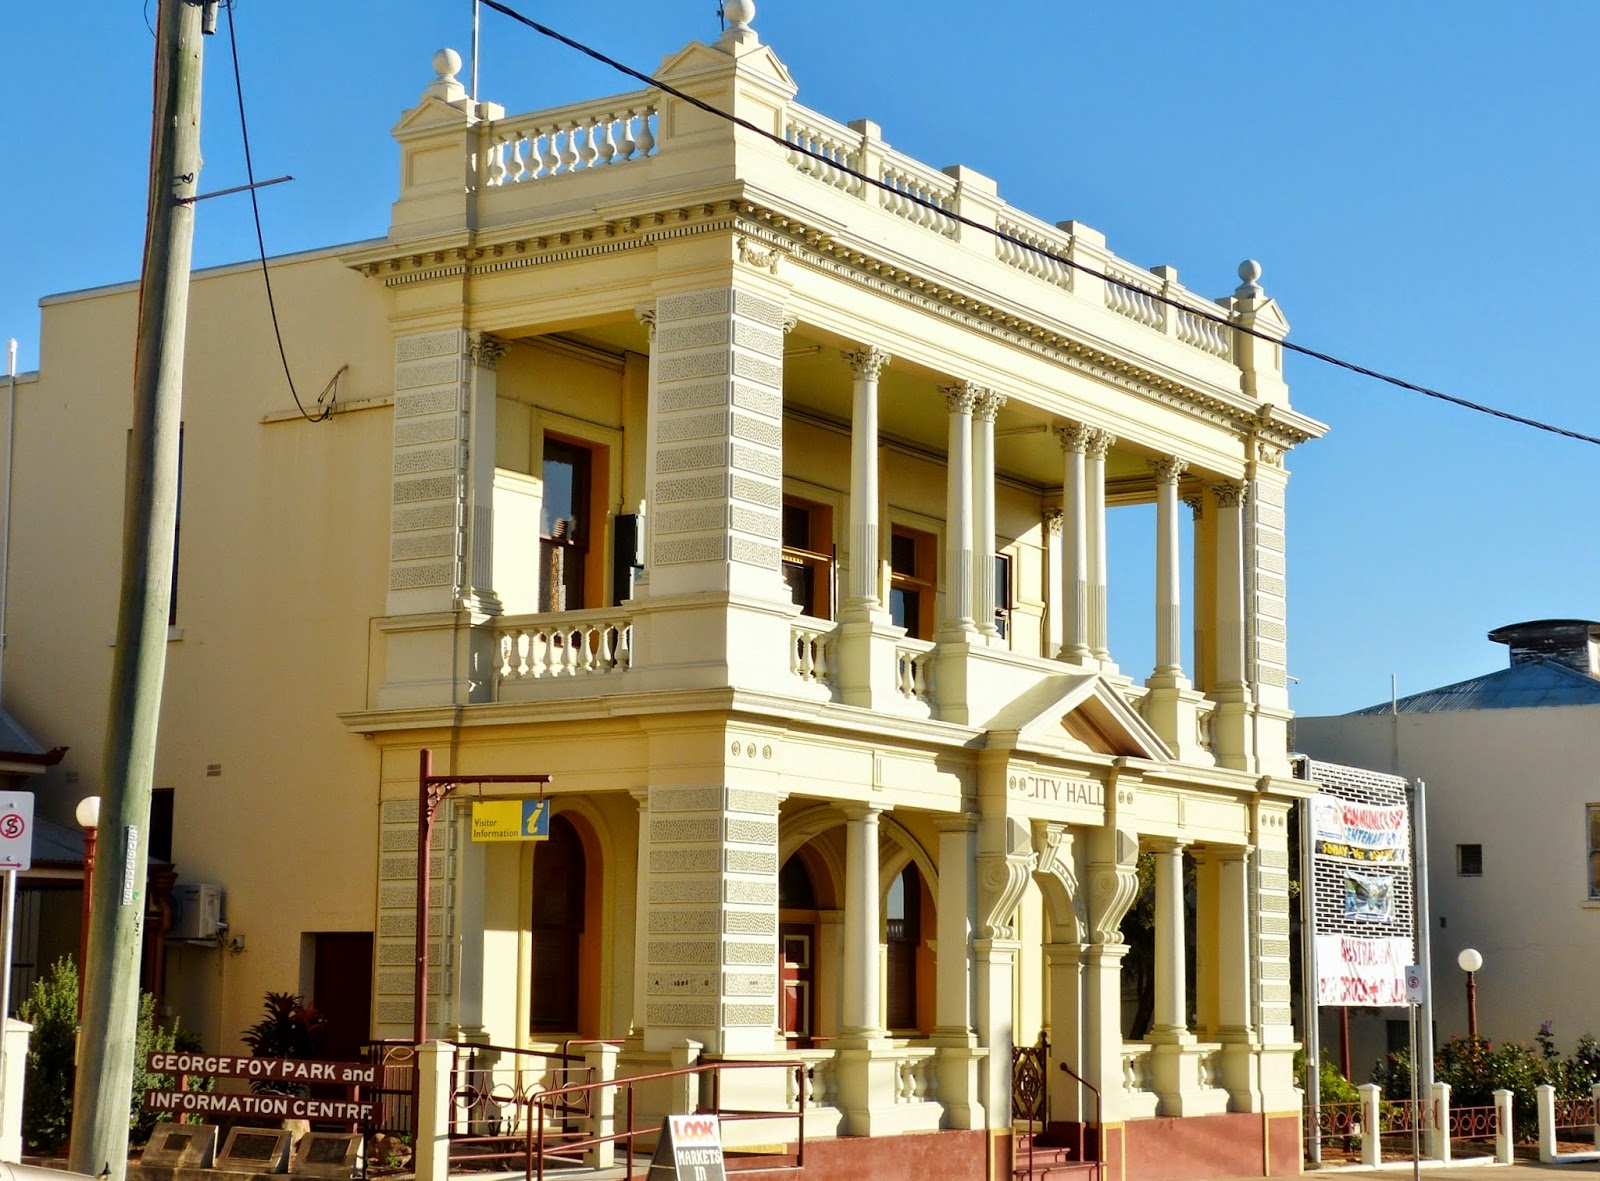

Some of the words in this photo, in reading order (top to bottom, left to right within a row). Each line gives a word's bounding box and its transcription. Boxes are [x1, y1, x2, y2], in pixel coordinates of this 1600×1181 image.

[1066, 782, 1105, 806] HALL
[474, 818, 497, 828] Visitor
[473, 829, 519, 838] Information
[152, 1054, 231, 1073] GEORGE
[236, 1059, 277, 1076] FOY
[281, 1061, 336, 1080] PARK
[342, 1067, 375, 1082] and
[150, 1091, 288, 1114] INFORMATION
[673, 1120, 715, 1138] LOOK
[676, 1149, 721, 1165] MARKETS
